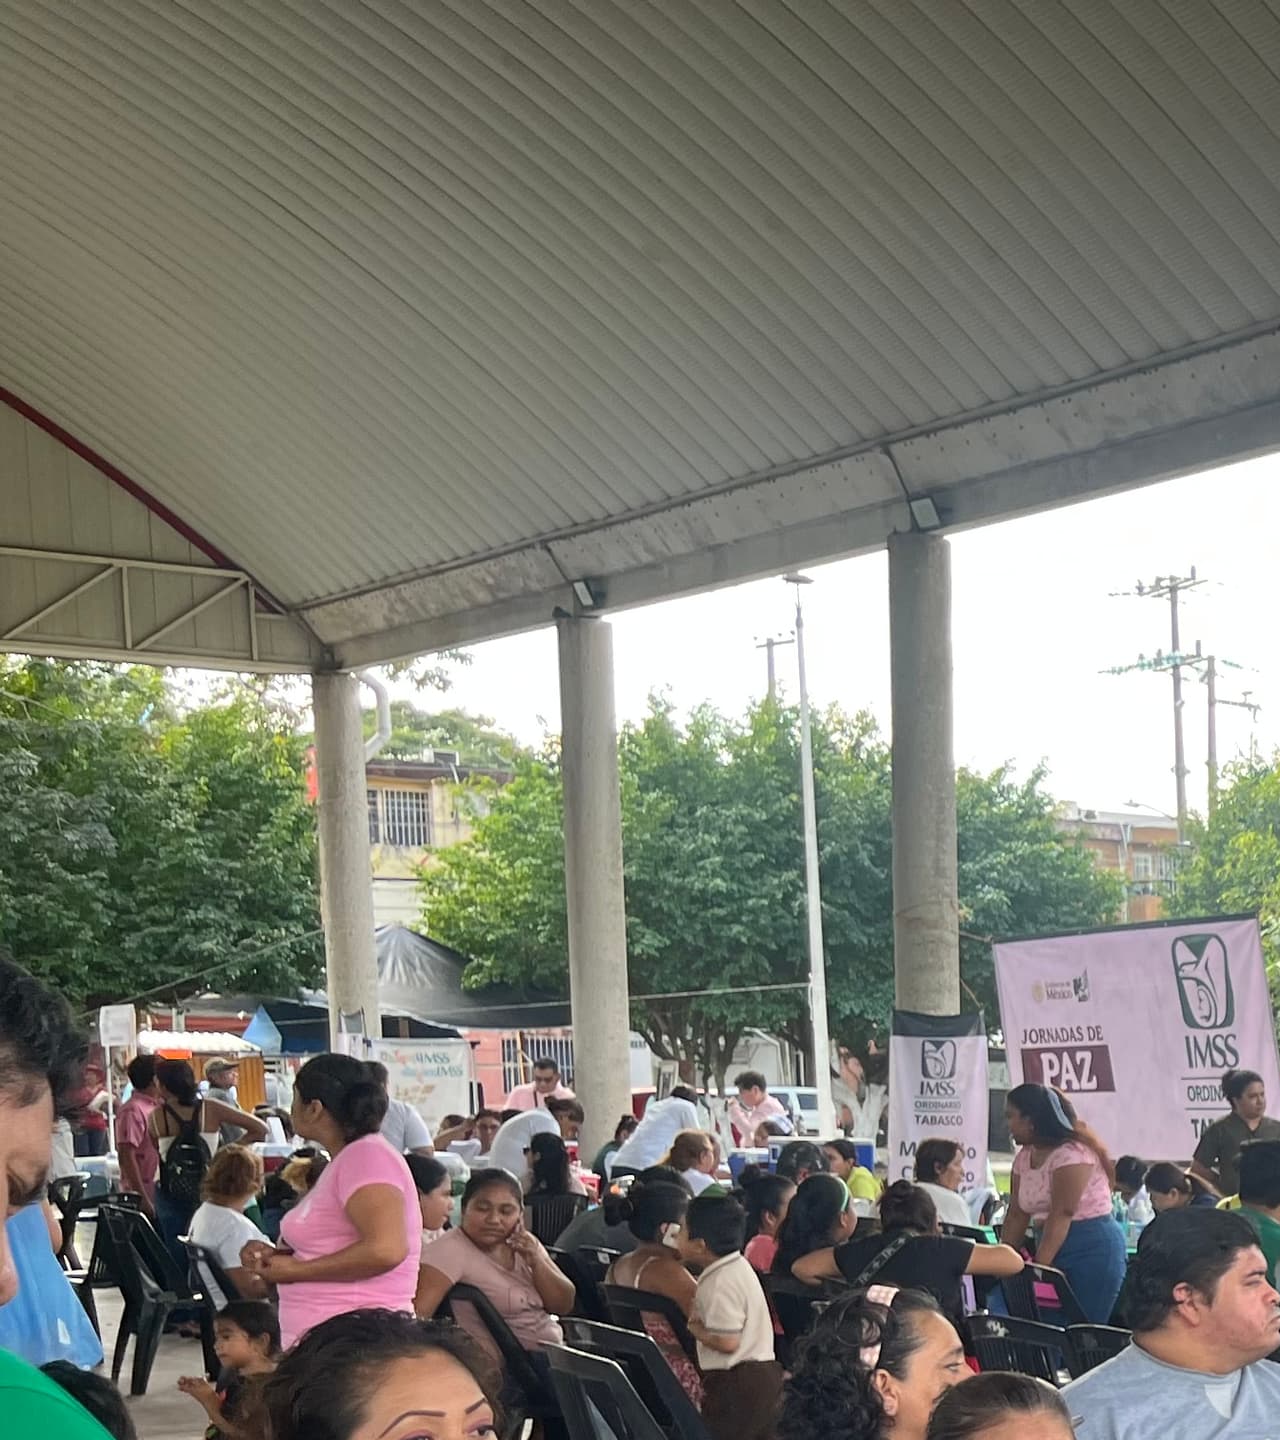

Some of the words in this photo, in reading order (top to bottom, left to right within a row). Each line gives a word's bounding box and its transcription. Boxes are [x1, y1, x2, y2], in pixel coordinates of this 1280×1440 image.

[1021, 1026, 1084, 1045] JORNADAS
[1086, 1025, 1104, 1041] DE
[1184, 1033, 1240, 1069] IMSS
[1040, 1050, 1098, 1091] PAZ
[919, 1081, 956, 1096] IMSS
[1186, 1085, 1226, 1102] ORDIN
[914, 1114, 964, 1127] TABASCO
